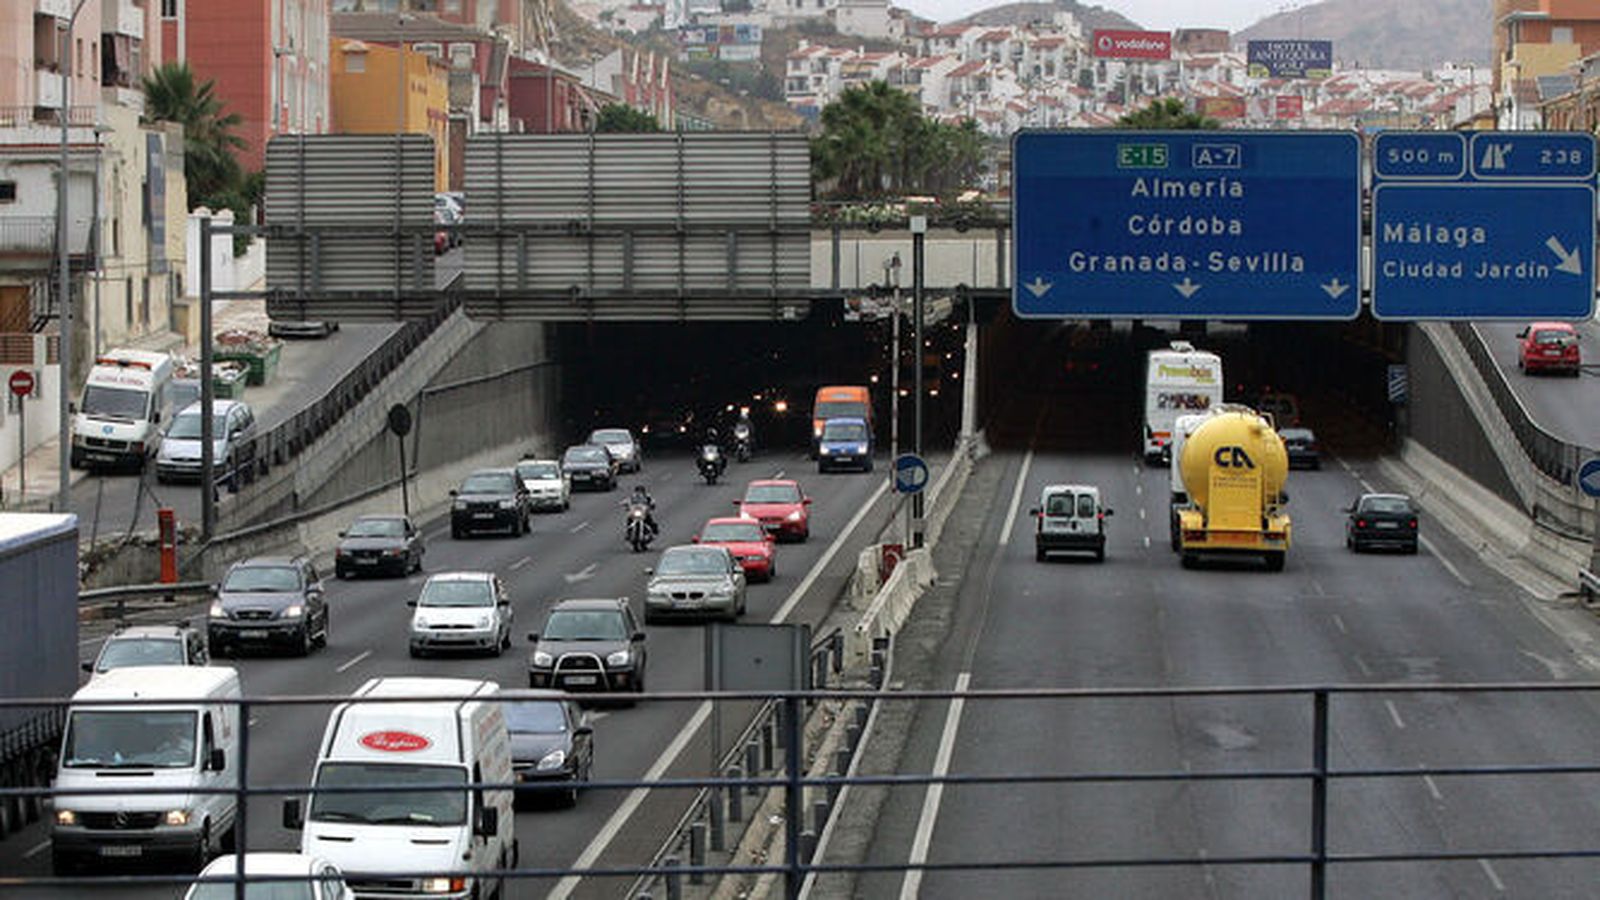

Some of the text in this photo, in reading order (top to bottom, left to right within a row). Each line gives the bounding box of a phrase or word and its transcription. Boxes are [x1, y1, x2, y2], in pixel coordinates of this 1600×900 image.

[1116, 39, 1167, 51] vodafone
[1120, 149, 1165, 164] E-15
[1198, 149, 1236, 164] A-7
[1388, 149, 1454, 164] 500 m
[1540, 150, 1582, 164] 238
[1131, 177, 1243, 197] Almería
[1128, 214, 1242, 235] Córdoba
[1384, 222, 1486, 248] Málaga
[1383, 261, 1549, 278] Ciudad Jardín
